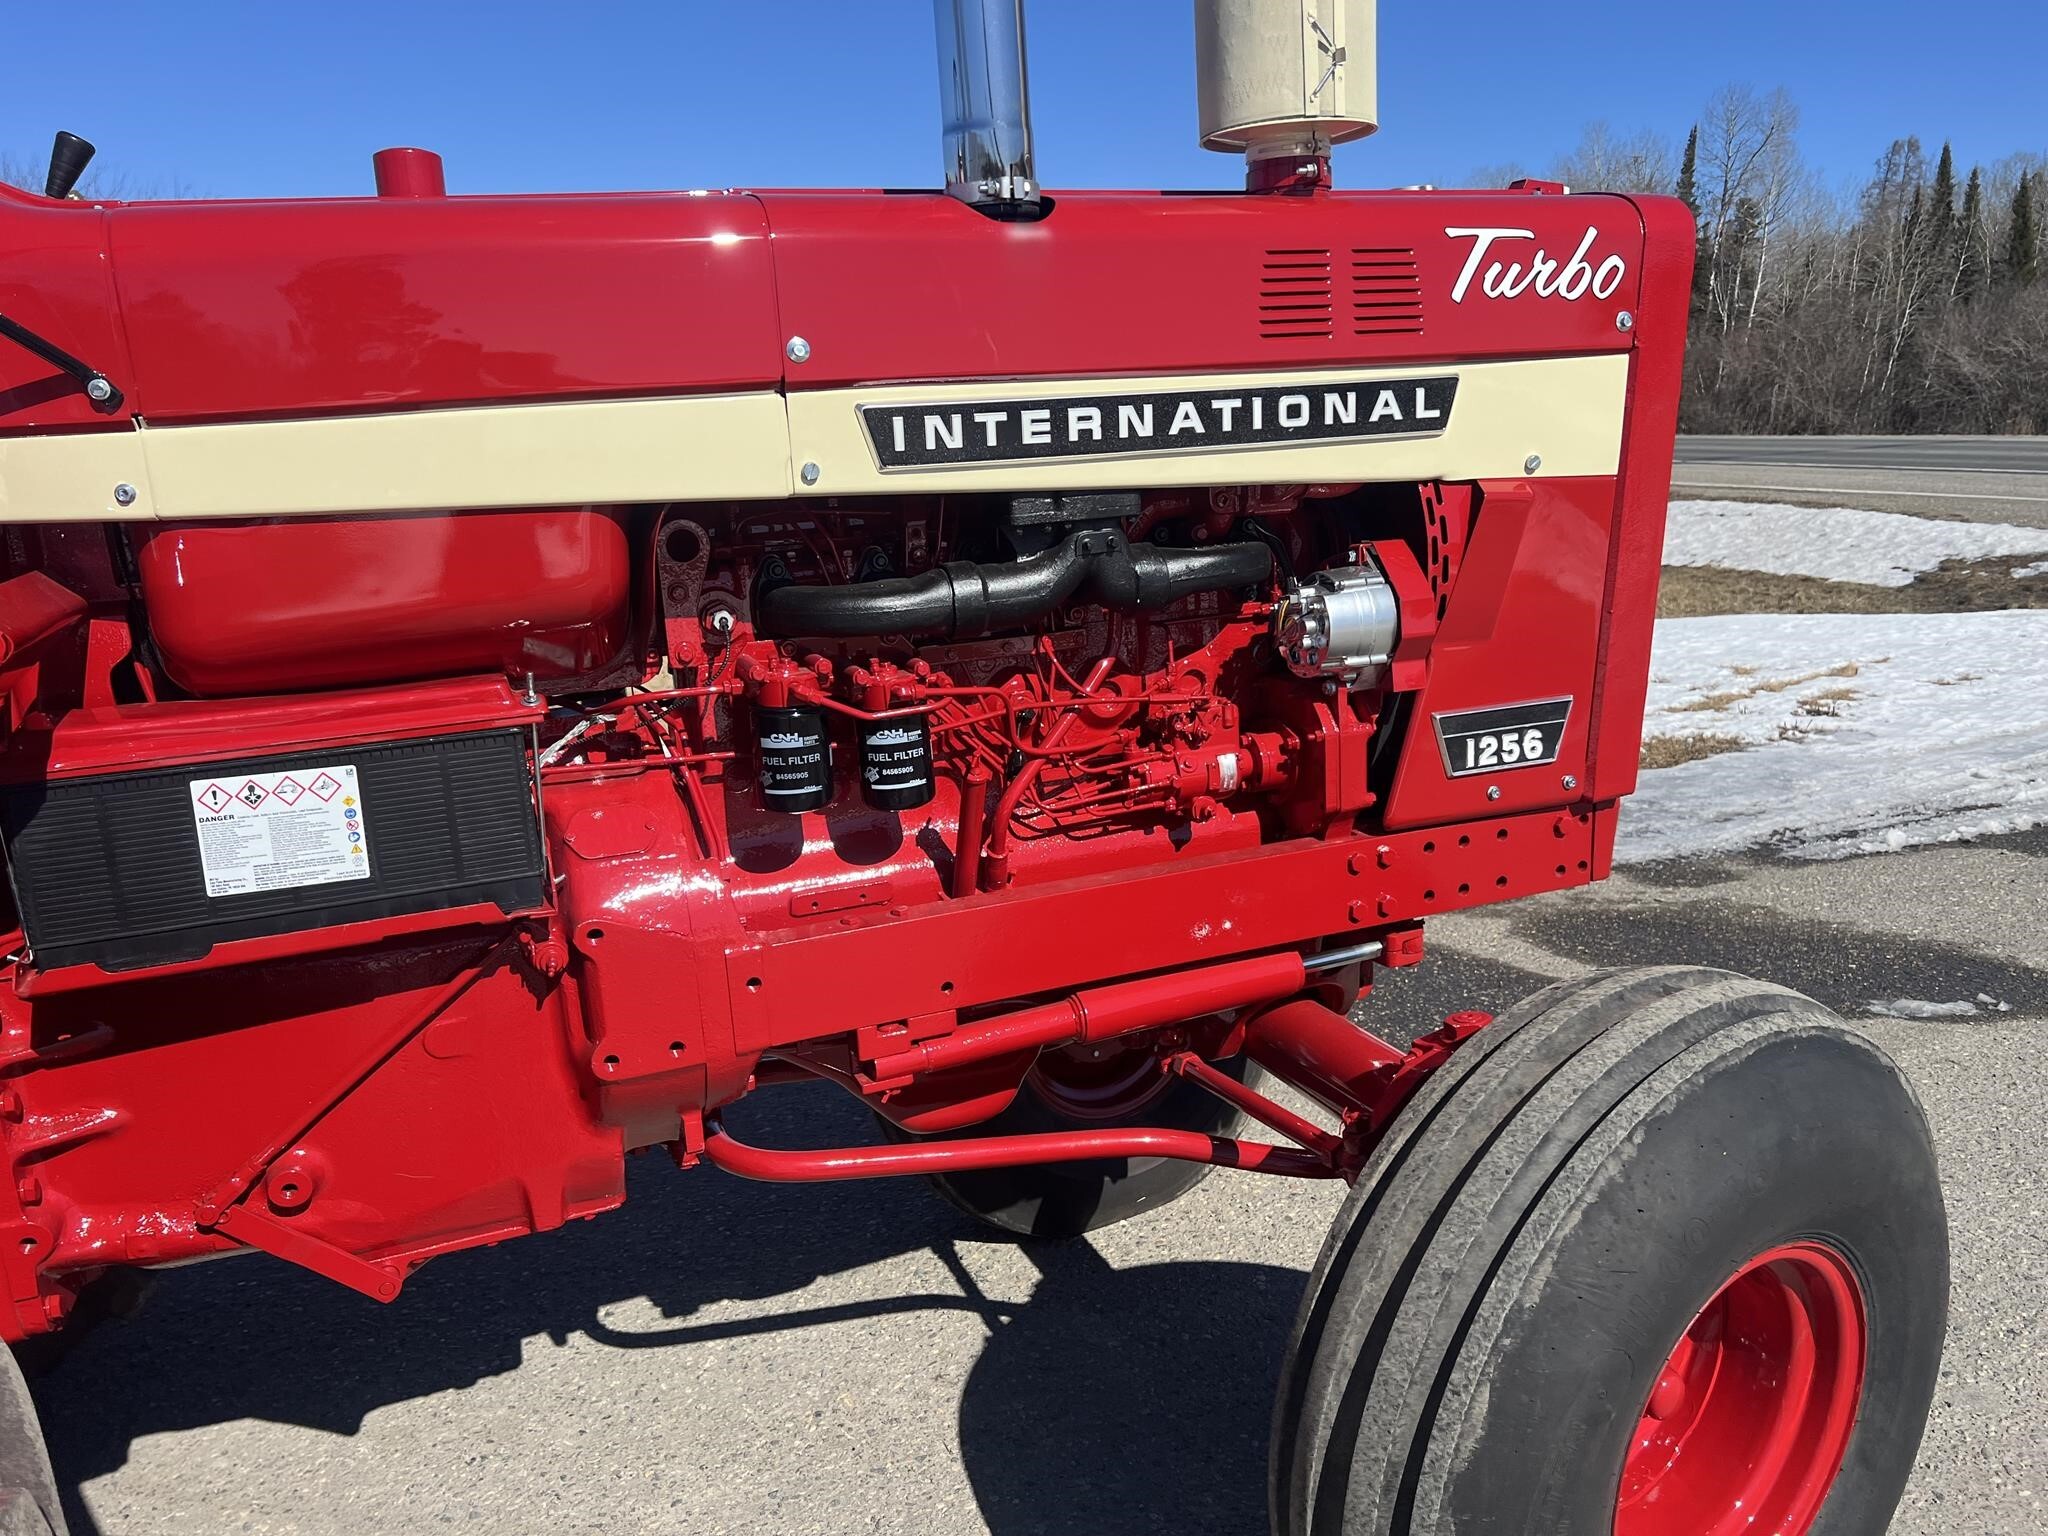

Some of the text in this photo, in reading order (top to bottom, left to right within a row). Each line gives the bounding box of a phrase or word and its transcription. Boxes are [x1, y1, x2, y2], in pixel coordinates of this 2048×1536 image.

[1444, 226, 1626, 304] Turbo
[892, 387, 1442, 452] INTERNATIONAL
[770, 732, 798, 742] CNH
[876, 728, 903, 739] CNH
[868, 747, 924, 762] FUEL FILTER
[1465, 728, 1544, 769] 1256
[762, 753, 821, 766] FUEL FILTER
[776, 772, 809, 780] 84565905
[882, 766, 914, 776] 84565905
[198, 814, 235, 823] DANGER
